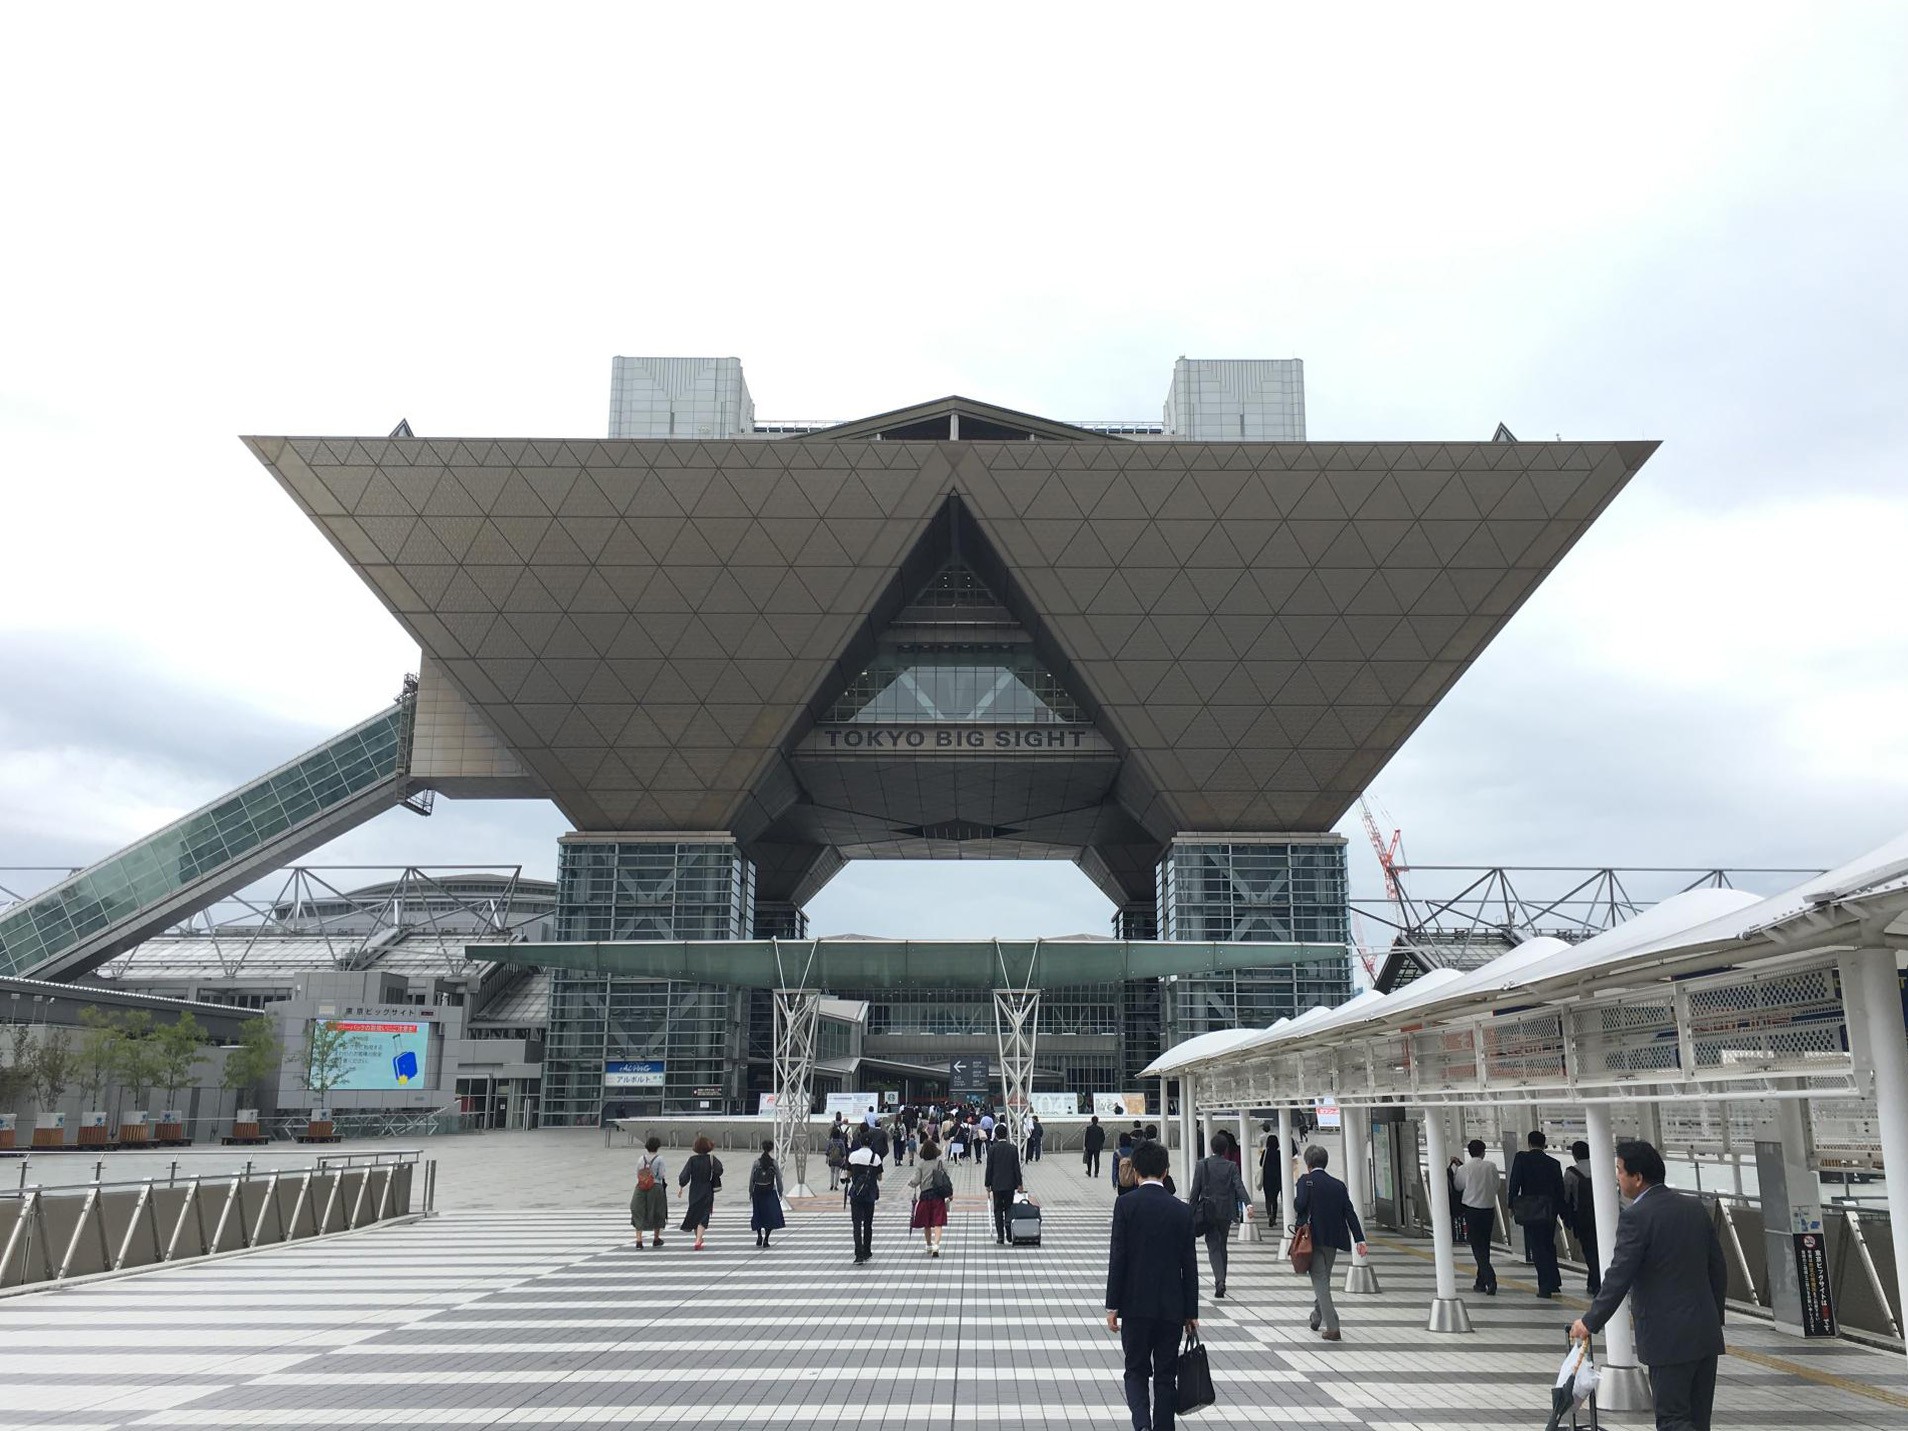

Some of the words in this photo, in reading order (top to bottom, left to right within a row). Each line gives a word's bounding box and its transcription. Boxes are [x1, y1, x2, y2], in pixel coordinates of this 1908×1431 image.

[825, 730, 925, 747] TOKYO
[936, 730, 985, 747] BIG
[995, 730, 1086, 747] SIGHT
[346, 1008, 414, 1016] 東京ビッグサイト
